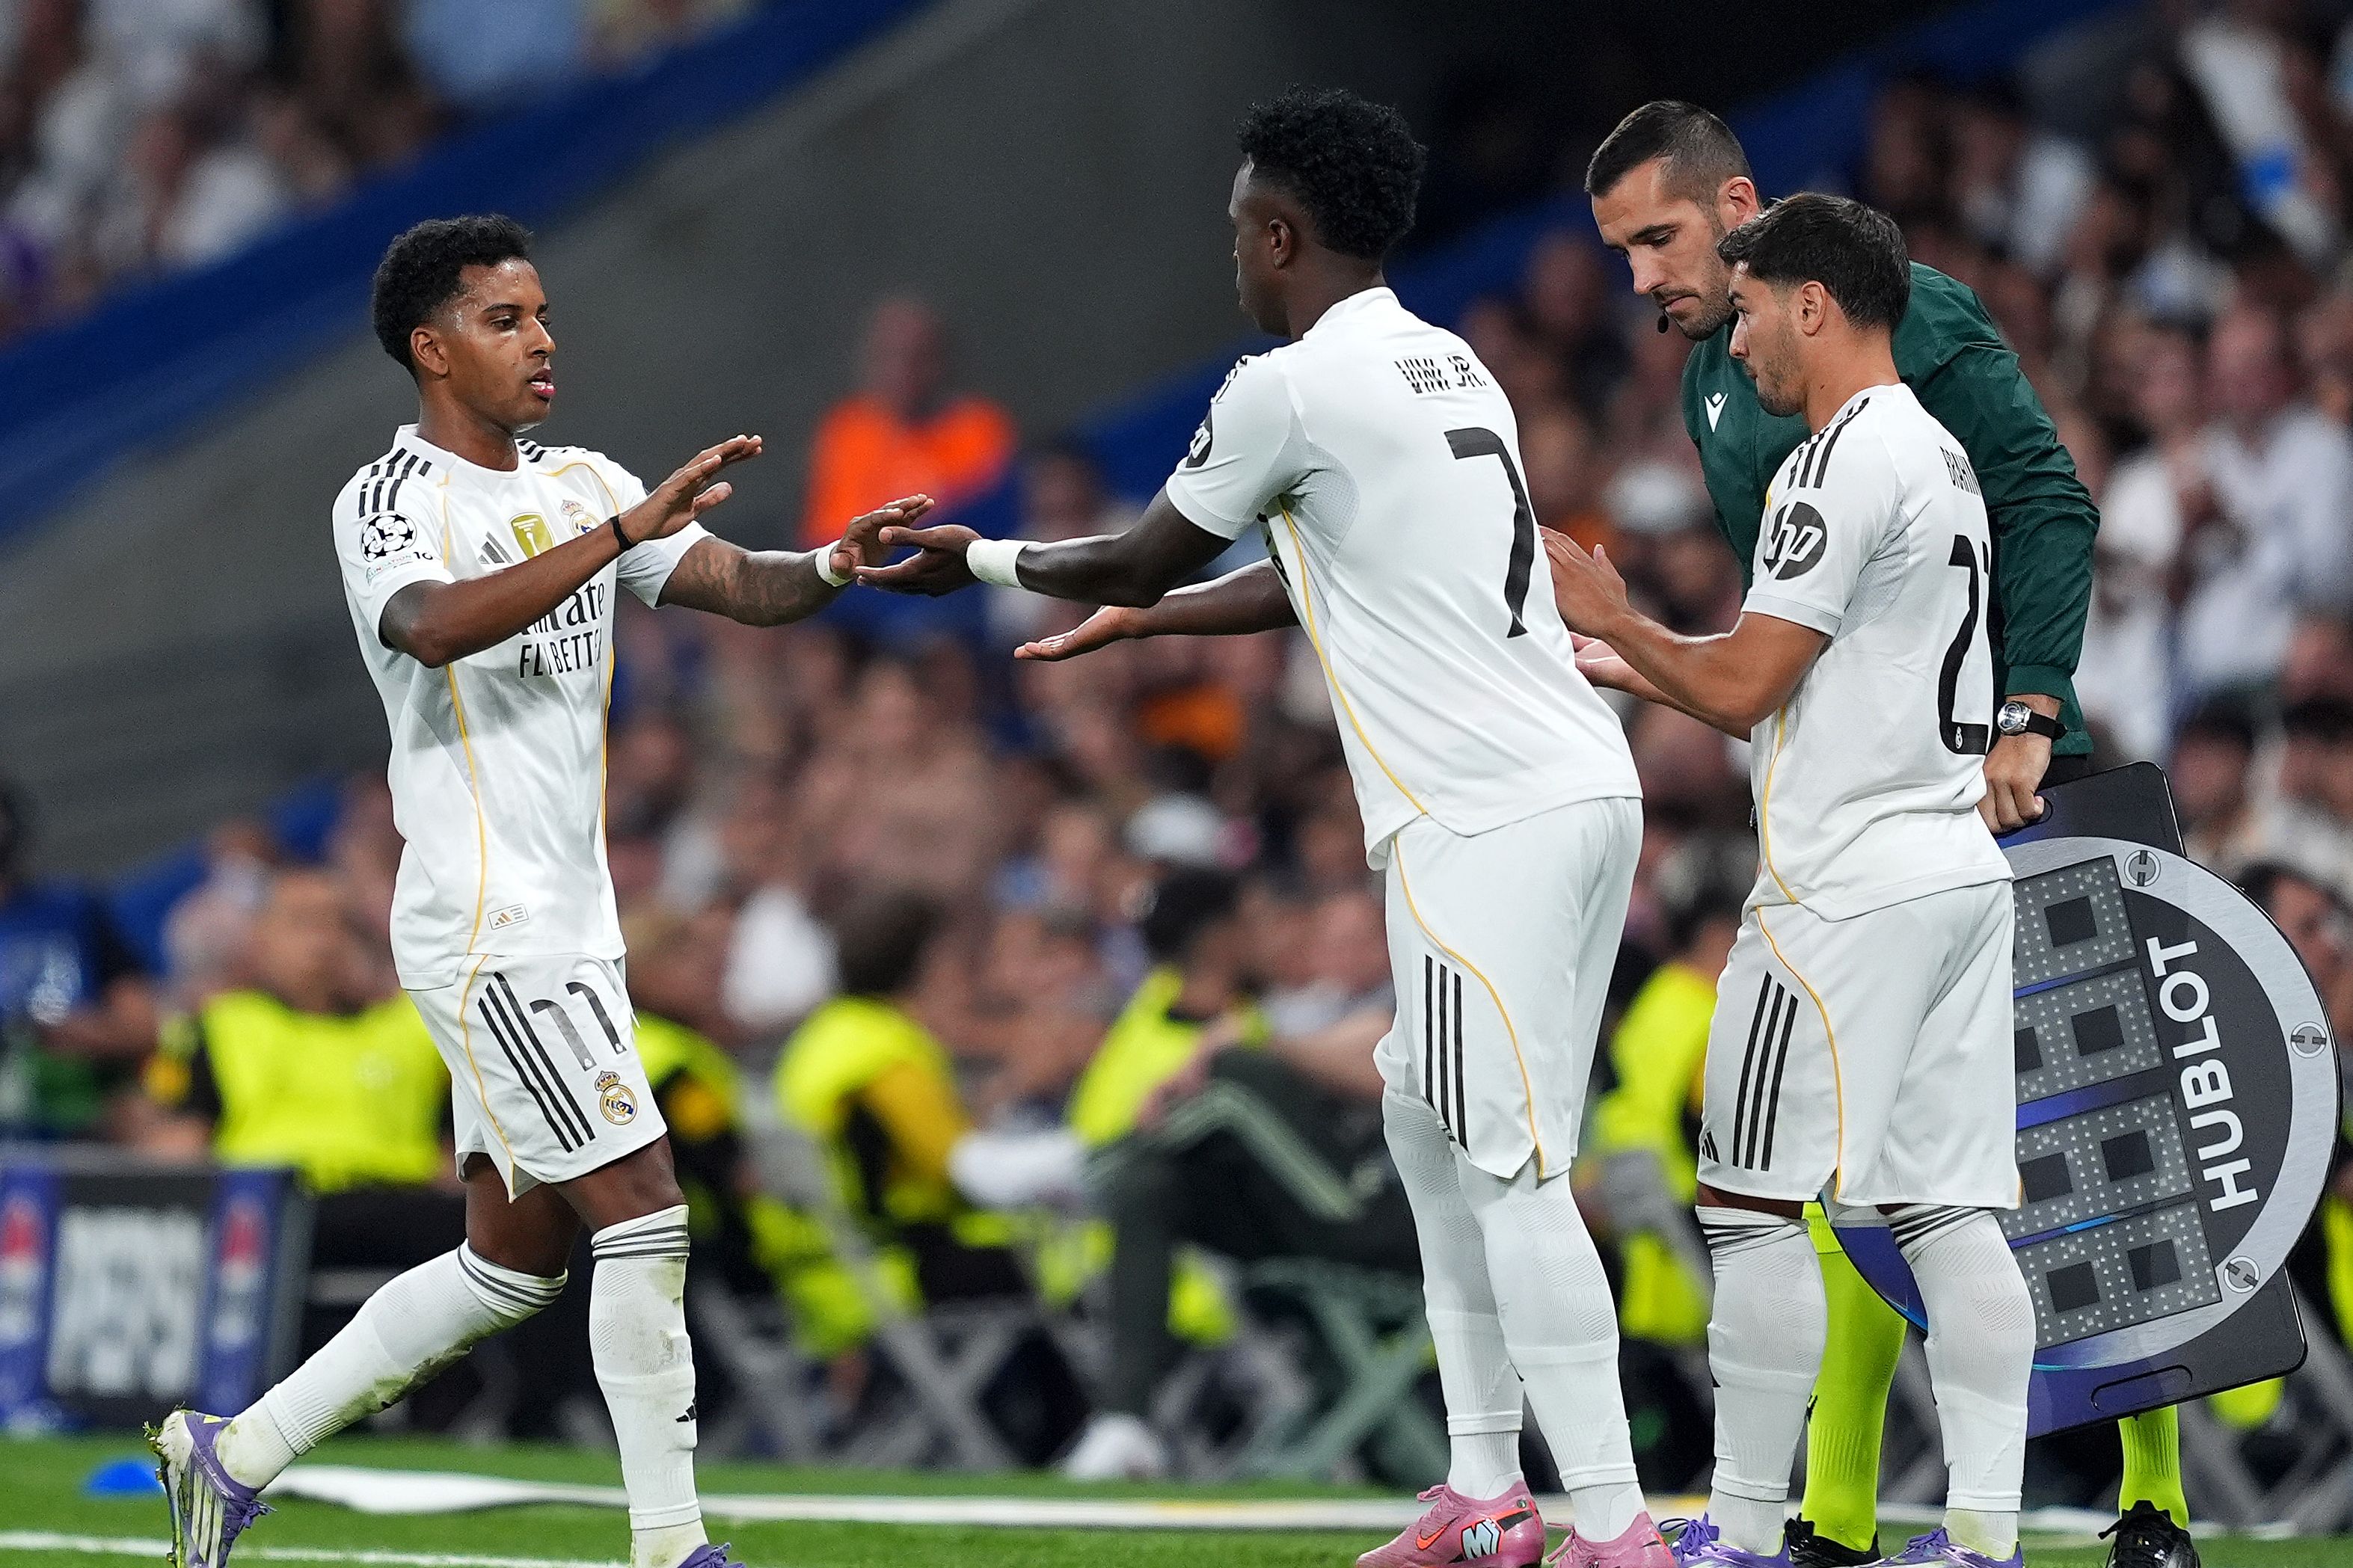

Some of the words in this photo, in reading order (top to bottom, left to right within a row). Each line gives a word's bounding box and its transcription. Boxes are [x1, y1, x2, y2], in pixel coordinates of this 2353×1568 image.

[1394, 357, 1451, 394] VINI
[1447, 355, 1487, 387] JR.
[1444, 427, 1527, 639] 7
[1764, 502, 1825, 579] hp
[1937, 534, 1990, 755] 2
[529, 982, 627, 1072] 11
[2146, 936, 2259, 1212] HUBLOT
